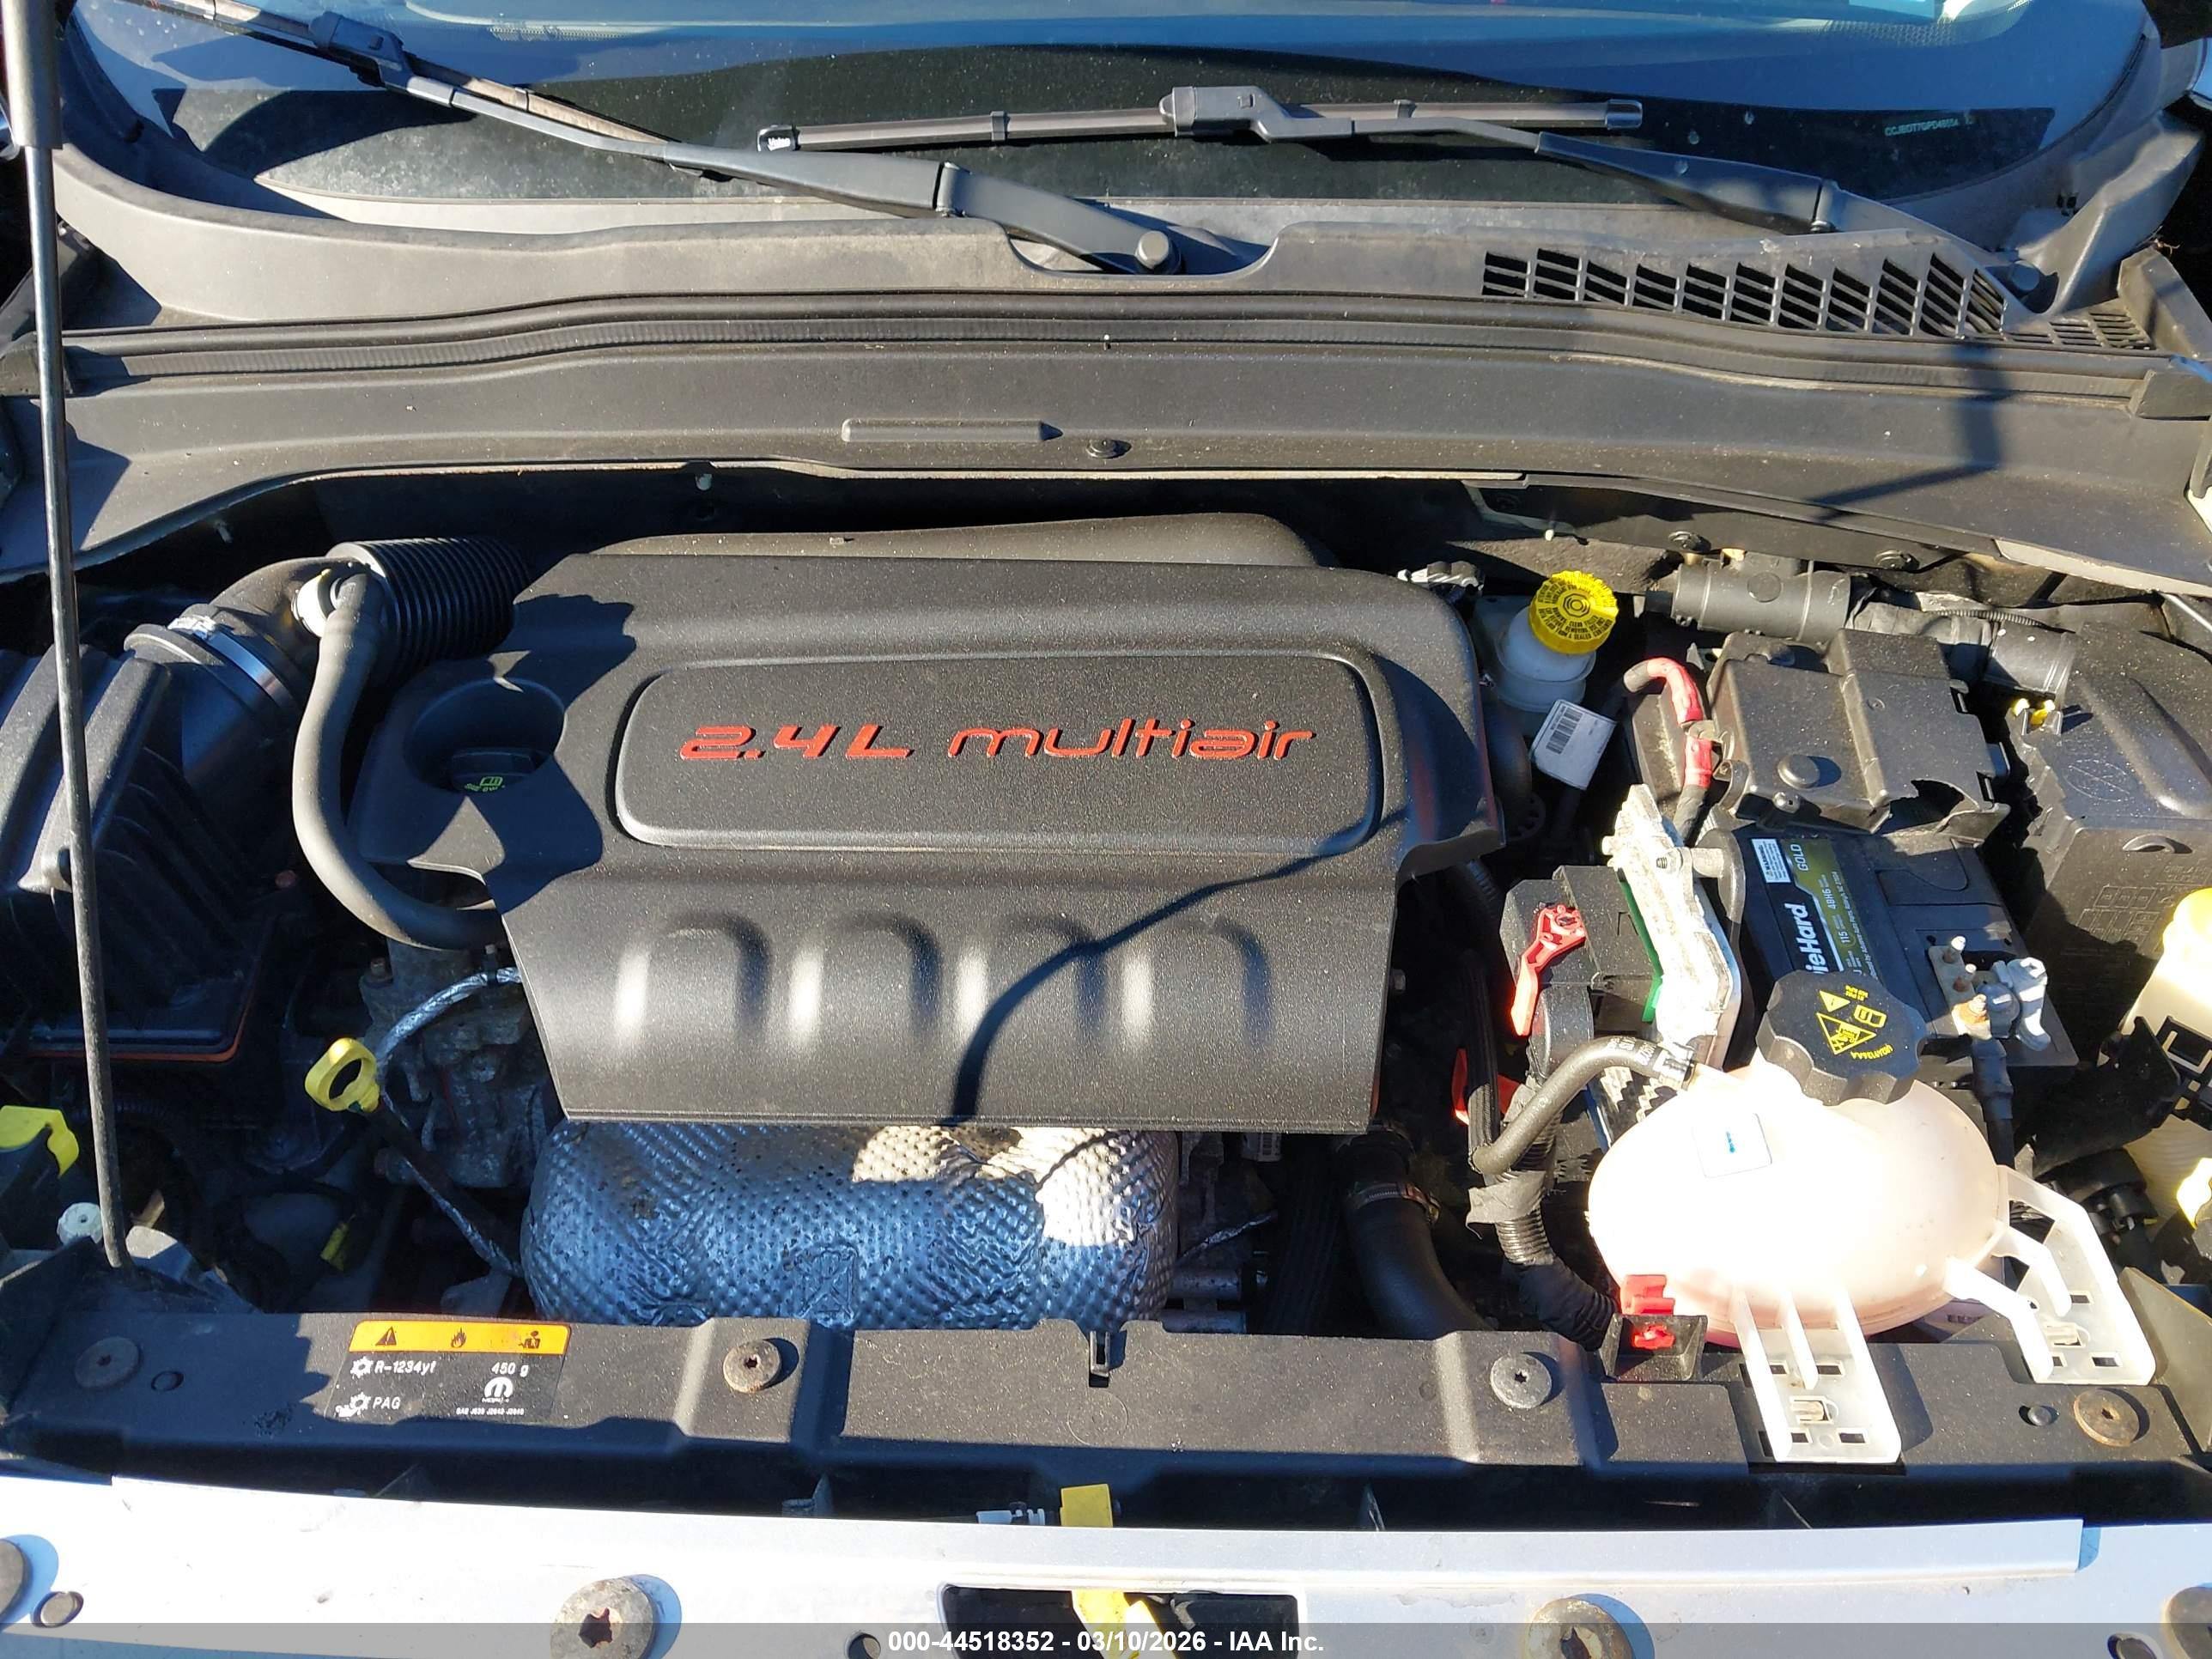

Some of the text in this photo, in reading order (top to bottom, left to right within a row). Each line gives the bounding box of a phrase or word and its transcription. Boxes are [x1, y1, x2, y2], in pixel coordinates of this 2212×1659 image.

[949, 719, 1314, 759] multiair
[1790, 843, 1808, 871] GOLD
[1838, 931, 1851, 944] 115
[490, 1362, 517, 1375] 450
[520, 1364, 530, 1377] g
[372, 1396, 401, 1411] PAG
